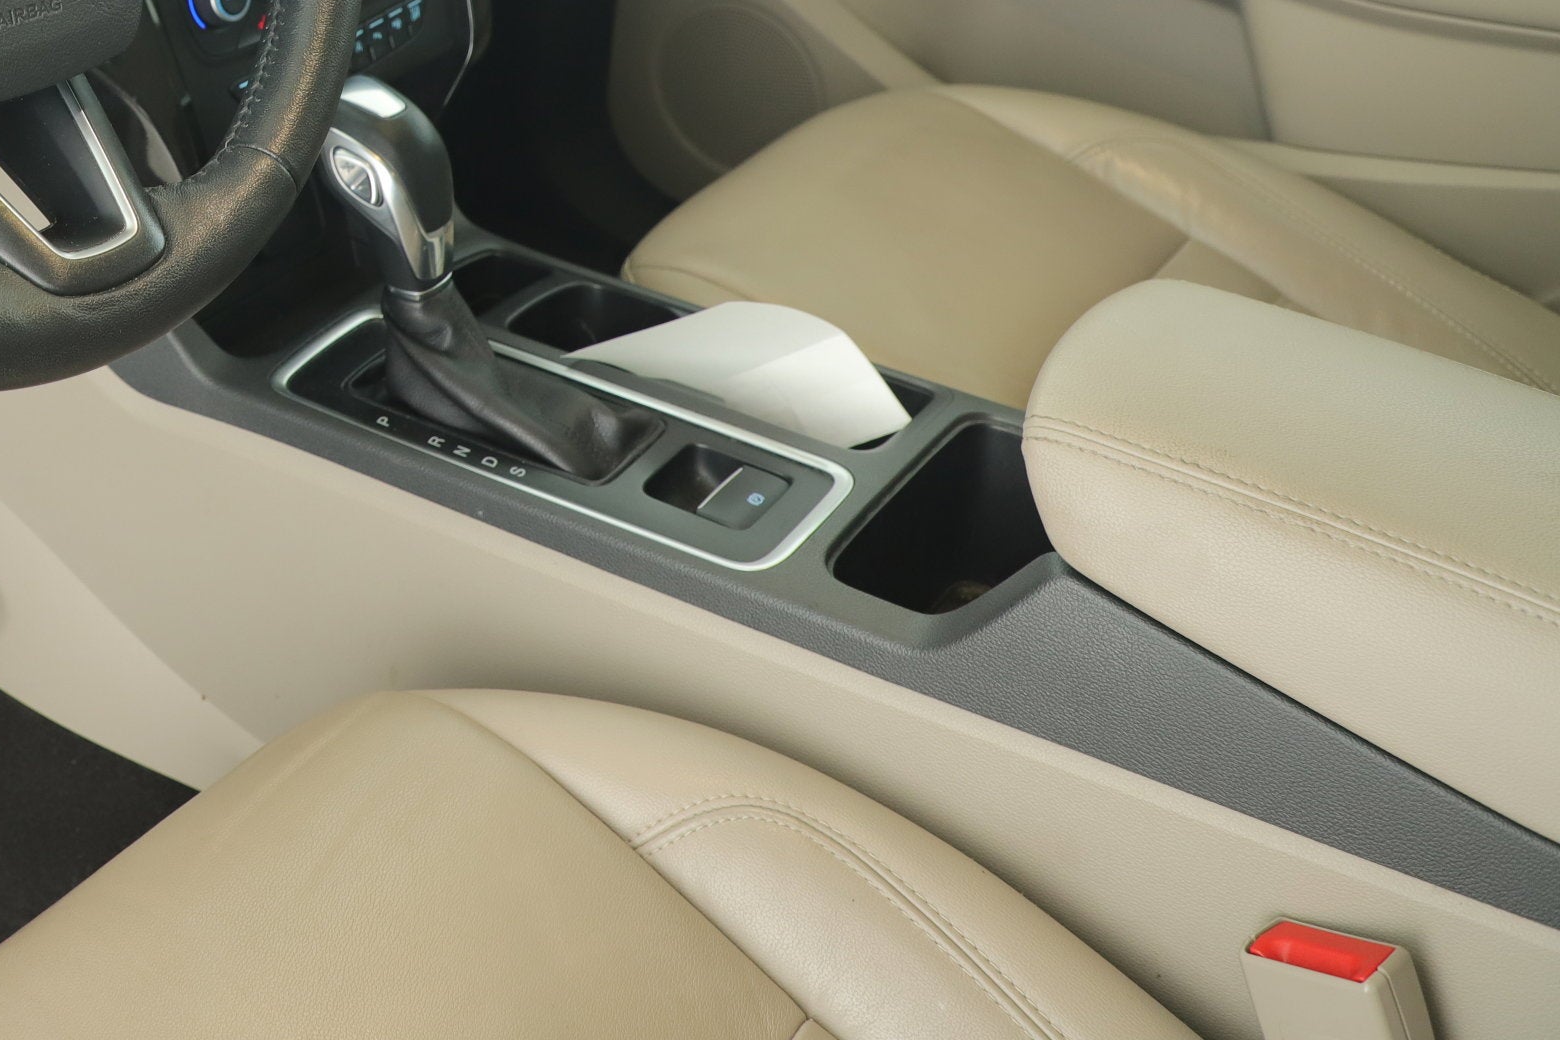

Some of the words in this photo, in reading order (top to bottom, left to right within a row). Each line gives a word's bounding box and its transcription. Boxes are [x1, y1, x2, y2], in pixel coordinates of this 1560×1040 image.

[376, 415, 390, 427] P
[427, 435, 446, 447] R
[452, 445, 471, 458] N
[481, 456, 498, 468] D
[509, 466, 527, 477] S
